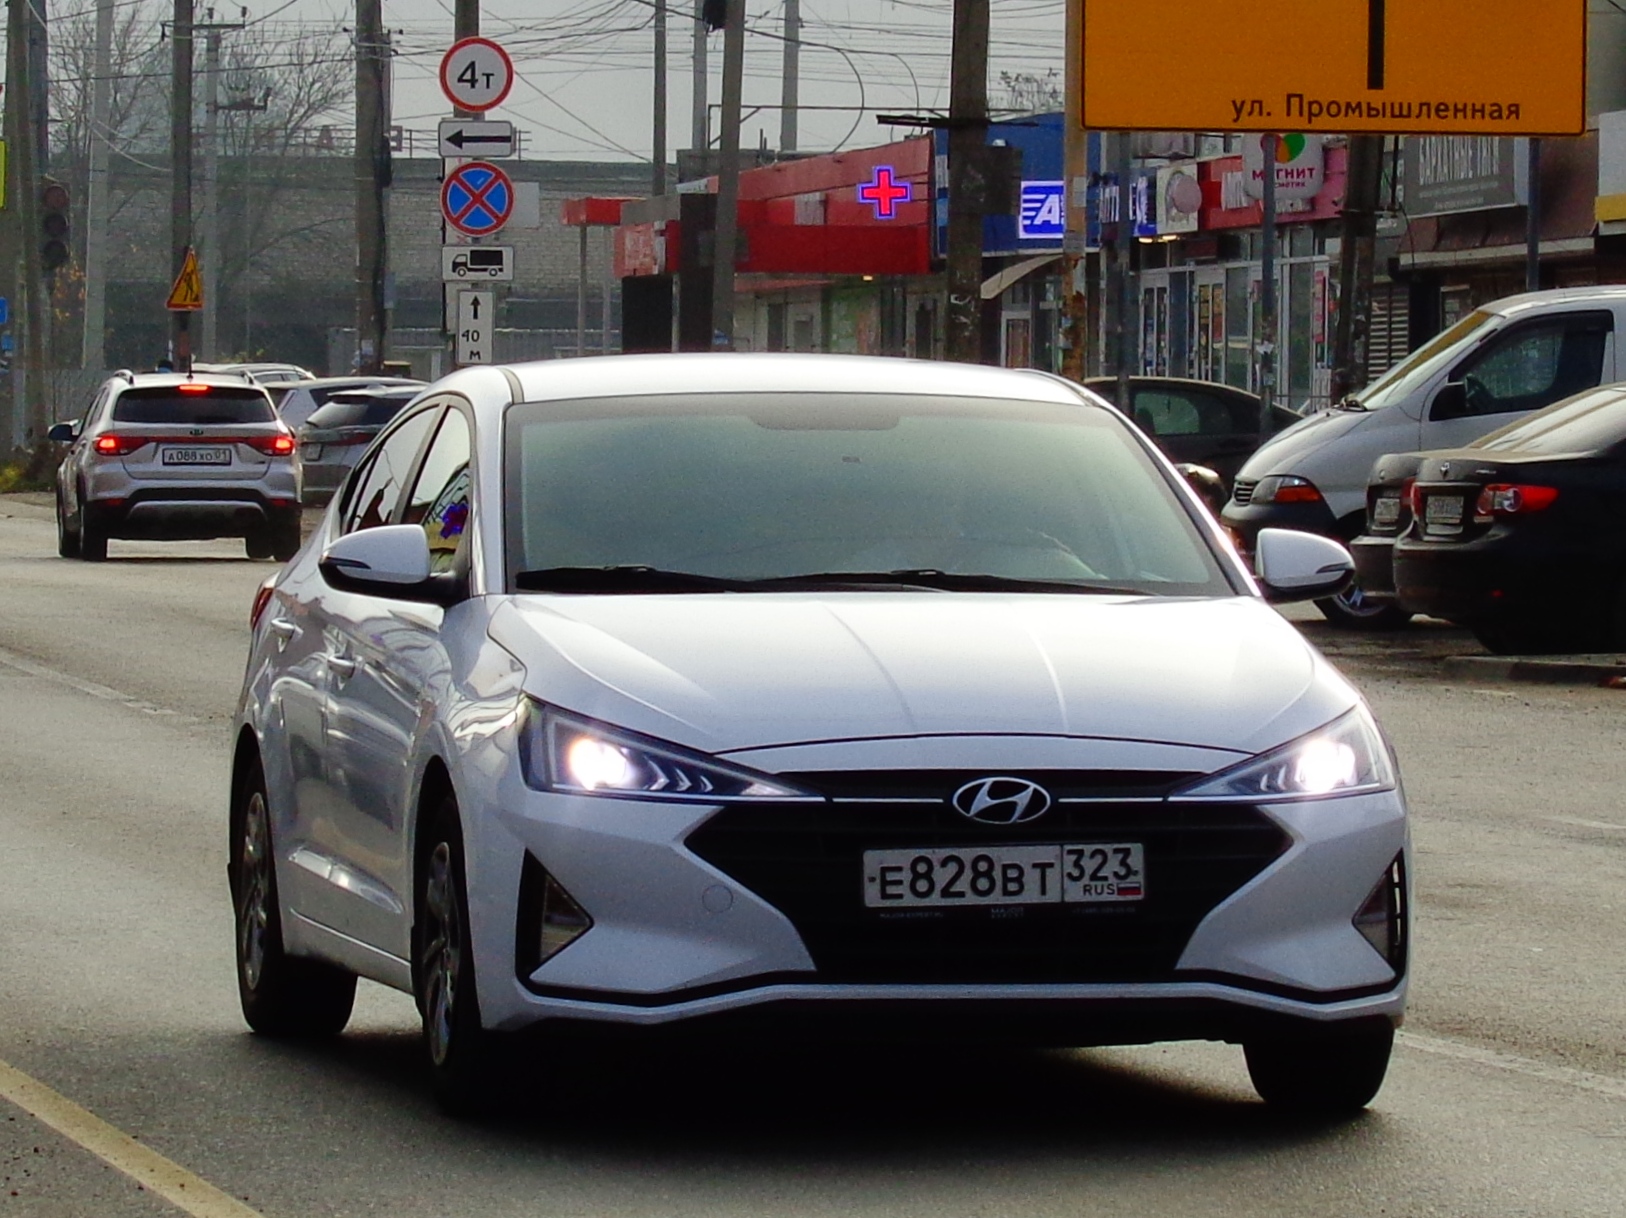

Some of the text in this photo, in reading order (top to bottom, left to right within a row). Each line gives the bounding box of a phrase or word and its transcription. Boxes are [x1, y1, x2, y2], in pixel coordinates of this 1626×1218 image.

[1231, 93, 1521, 124] ул. Промышленная
[1252, 168, 1316, 181] МГНИТ
[461, 329, 480, 343] 40
[1066, 848, 1132, 882] 323
[1083, 883, 1116, 896] RUS
